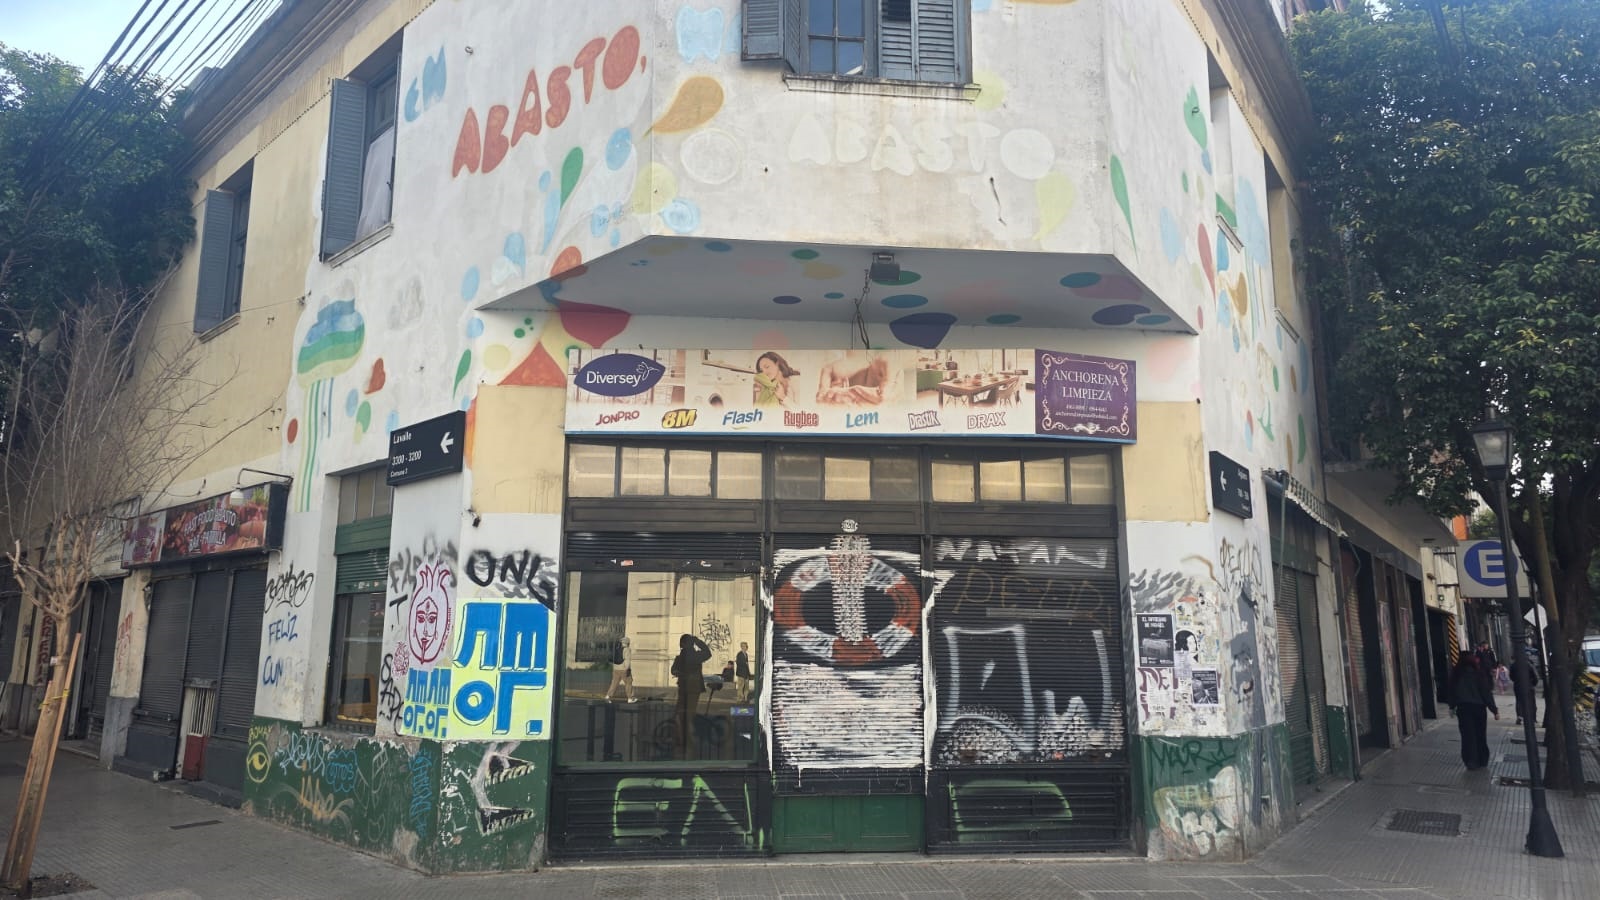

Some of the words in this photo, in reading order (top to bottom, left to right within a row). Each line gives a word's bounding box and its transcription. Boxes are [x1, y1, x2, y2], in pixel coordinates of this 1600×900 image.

[586, 370, 642, 388] Diversey
[1052, 369, 1120, 386] ANCHORENA
[1062, 386, 1113, 402] LIMPIEZA
[661, 408, 698, 429] 8M
[722, 409, 763, 426] Flash
[783, 410, 819, 428] Rugbee
[845, 410, 879, 429] Lem
[967, 412, 1007, 430] DRAX
[1477, 548, 1507, 579] E
